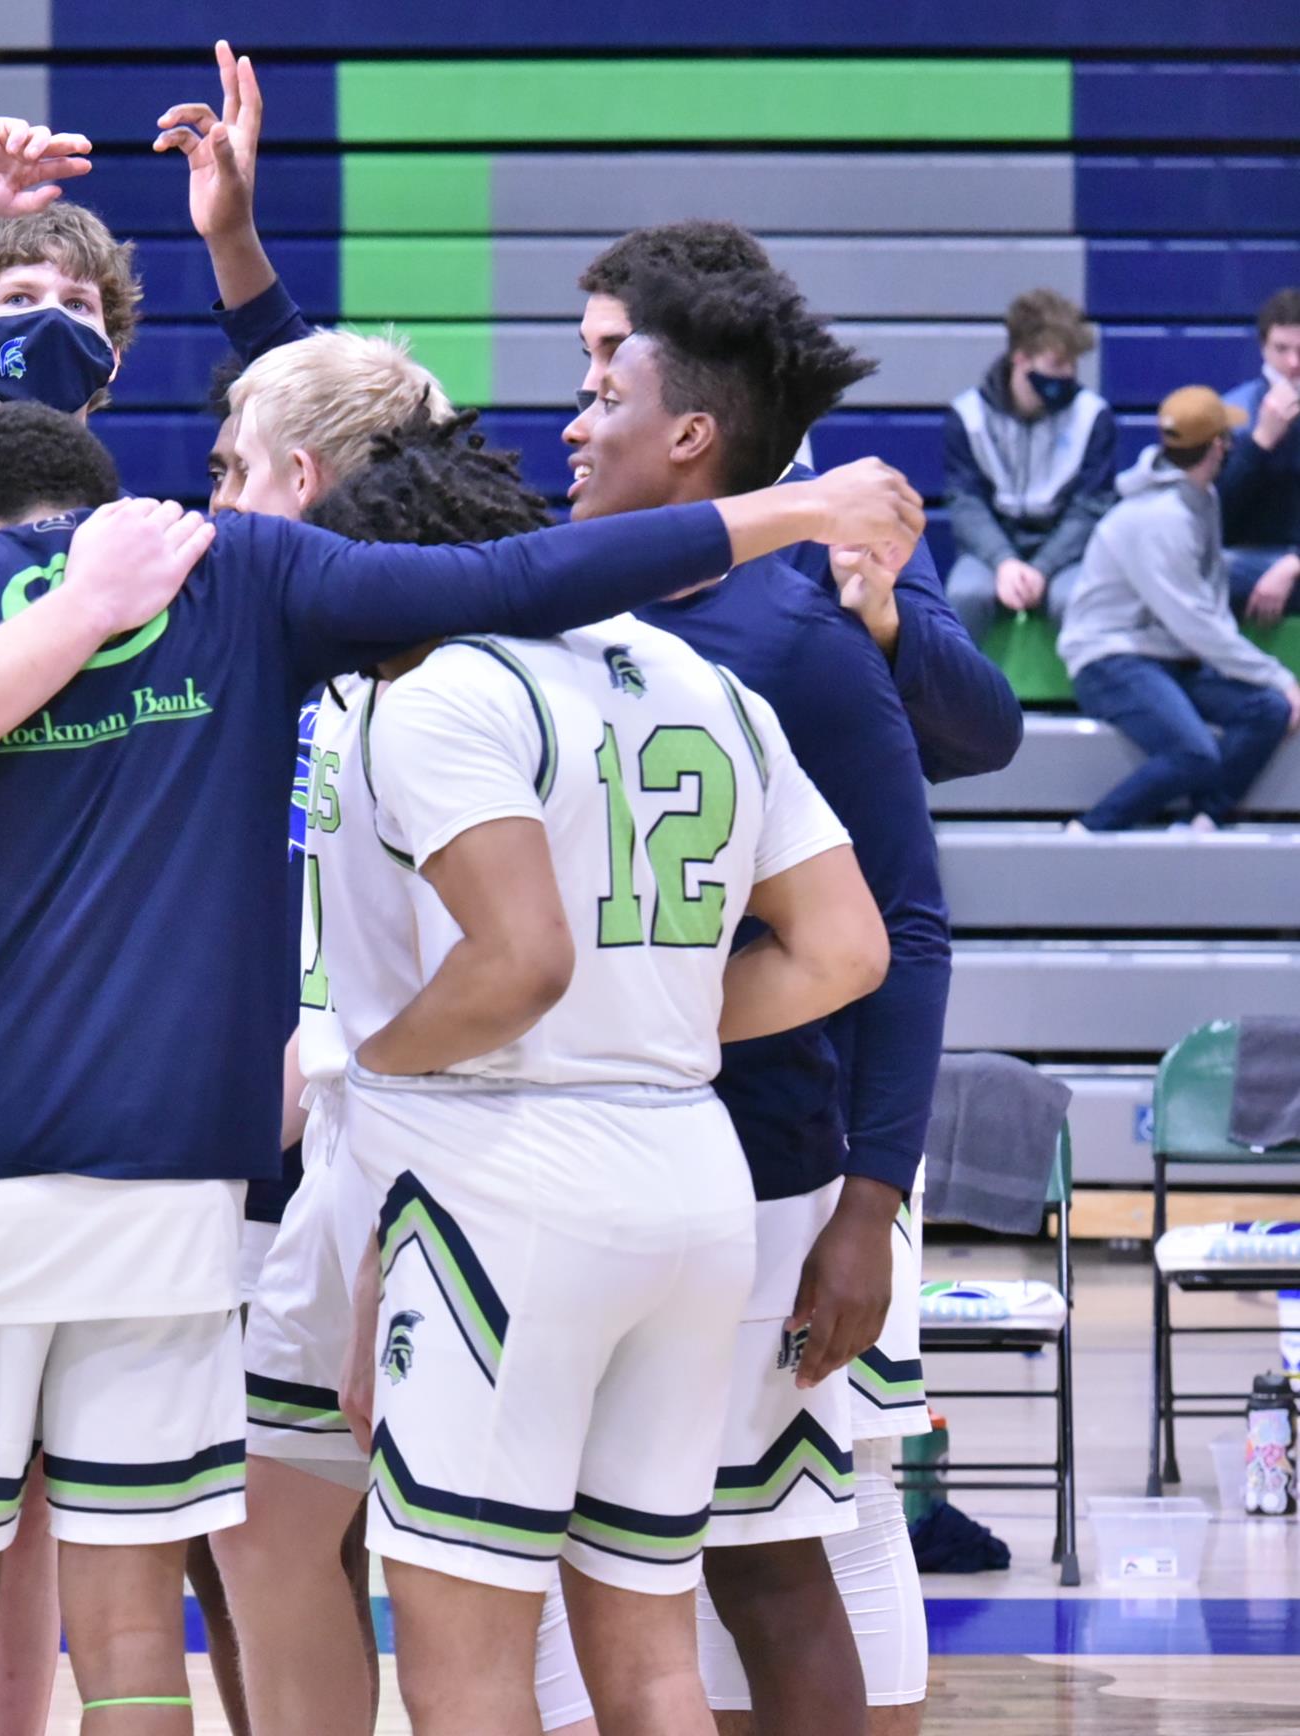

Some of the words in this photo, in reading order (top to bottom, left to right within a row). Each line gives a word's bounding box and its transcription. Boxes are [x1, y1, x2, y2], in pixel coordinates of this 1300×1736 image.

[0, 710, 128, 746] tockman
[131, 677, 209, 720] Bank
[594, 720, 737, 948] 12
